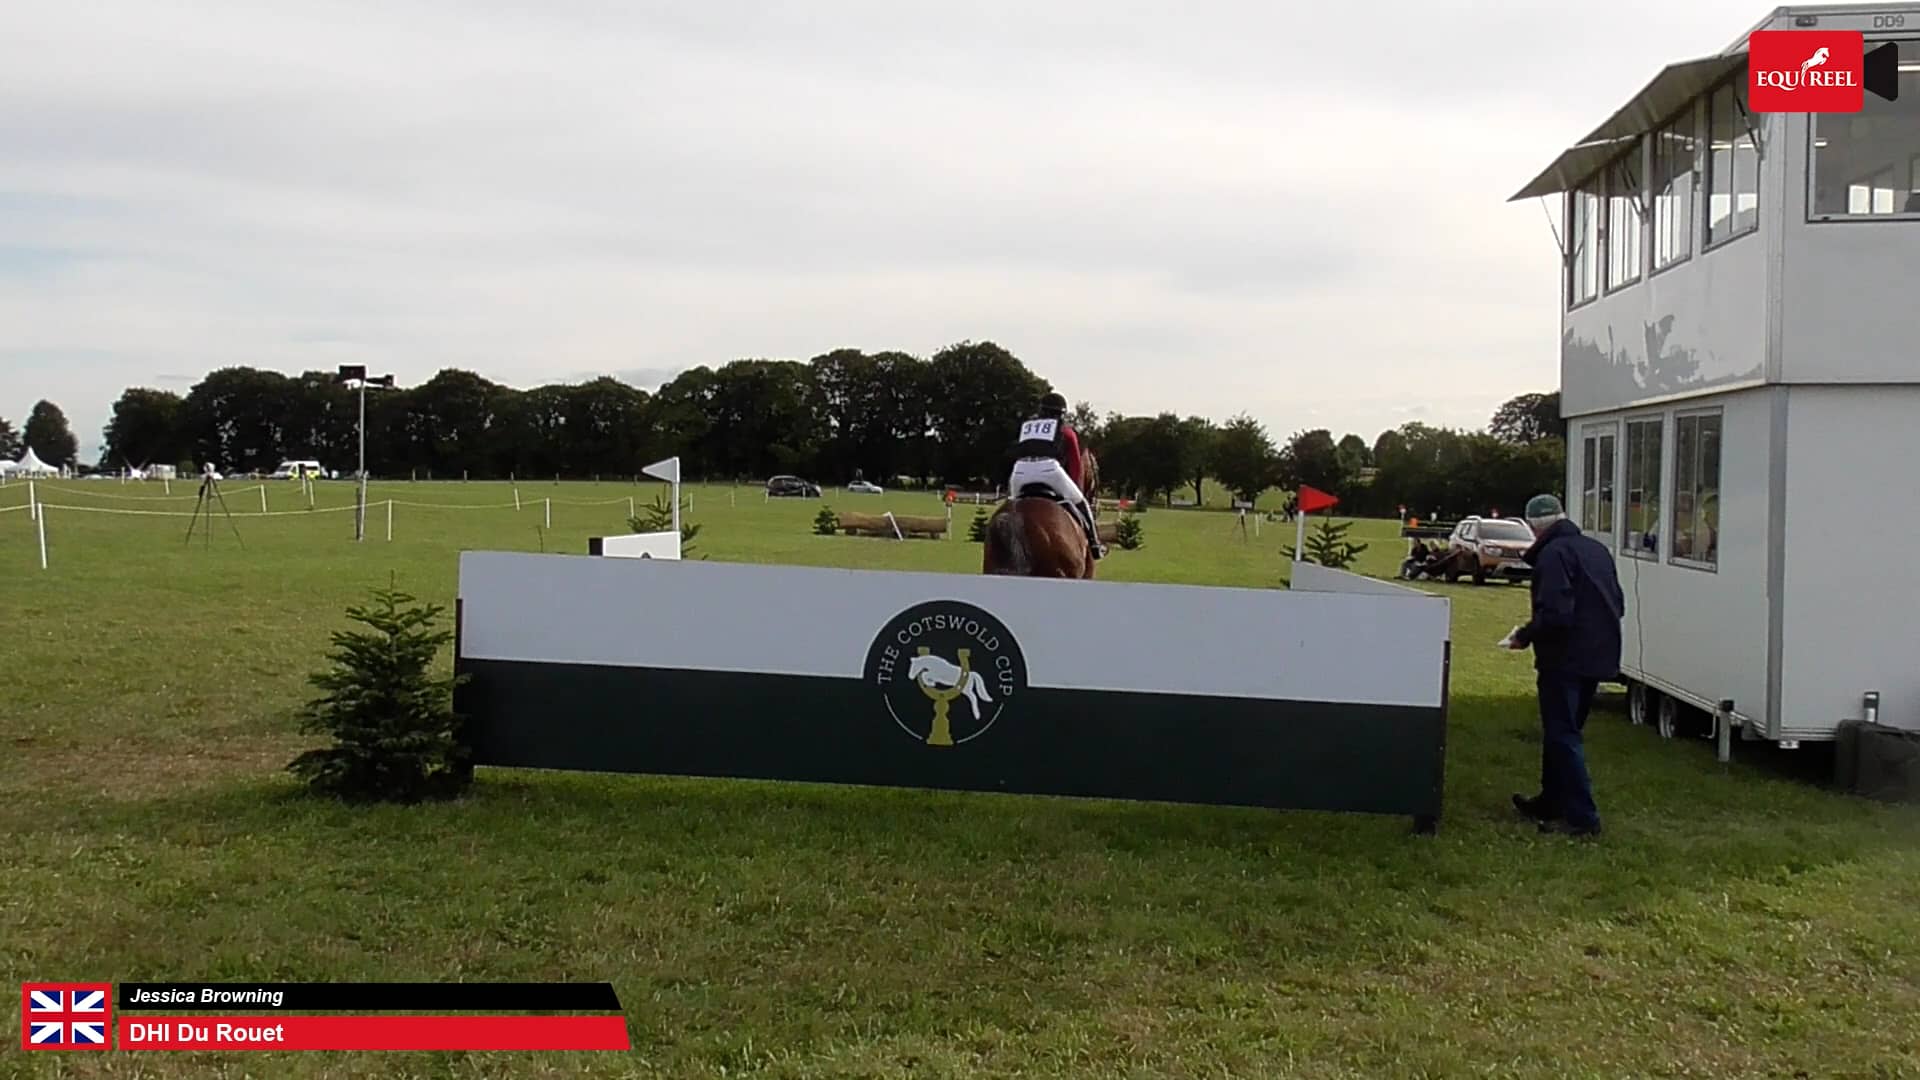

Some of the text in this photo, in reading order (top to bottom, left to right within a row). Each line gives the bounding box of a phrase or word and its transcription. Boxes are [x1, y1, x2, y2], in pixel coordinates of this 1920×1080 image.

[1873, 15, 1905, 28] DD9
[1023, 423, 1052, 435] 318
[878, 615, 1013, 696] THE COTSWOLD CUP
